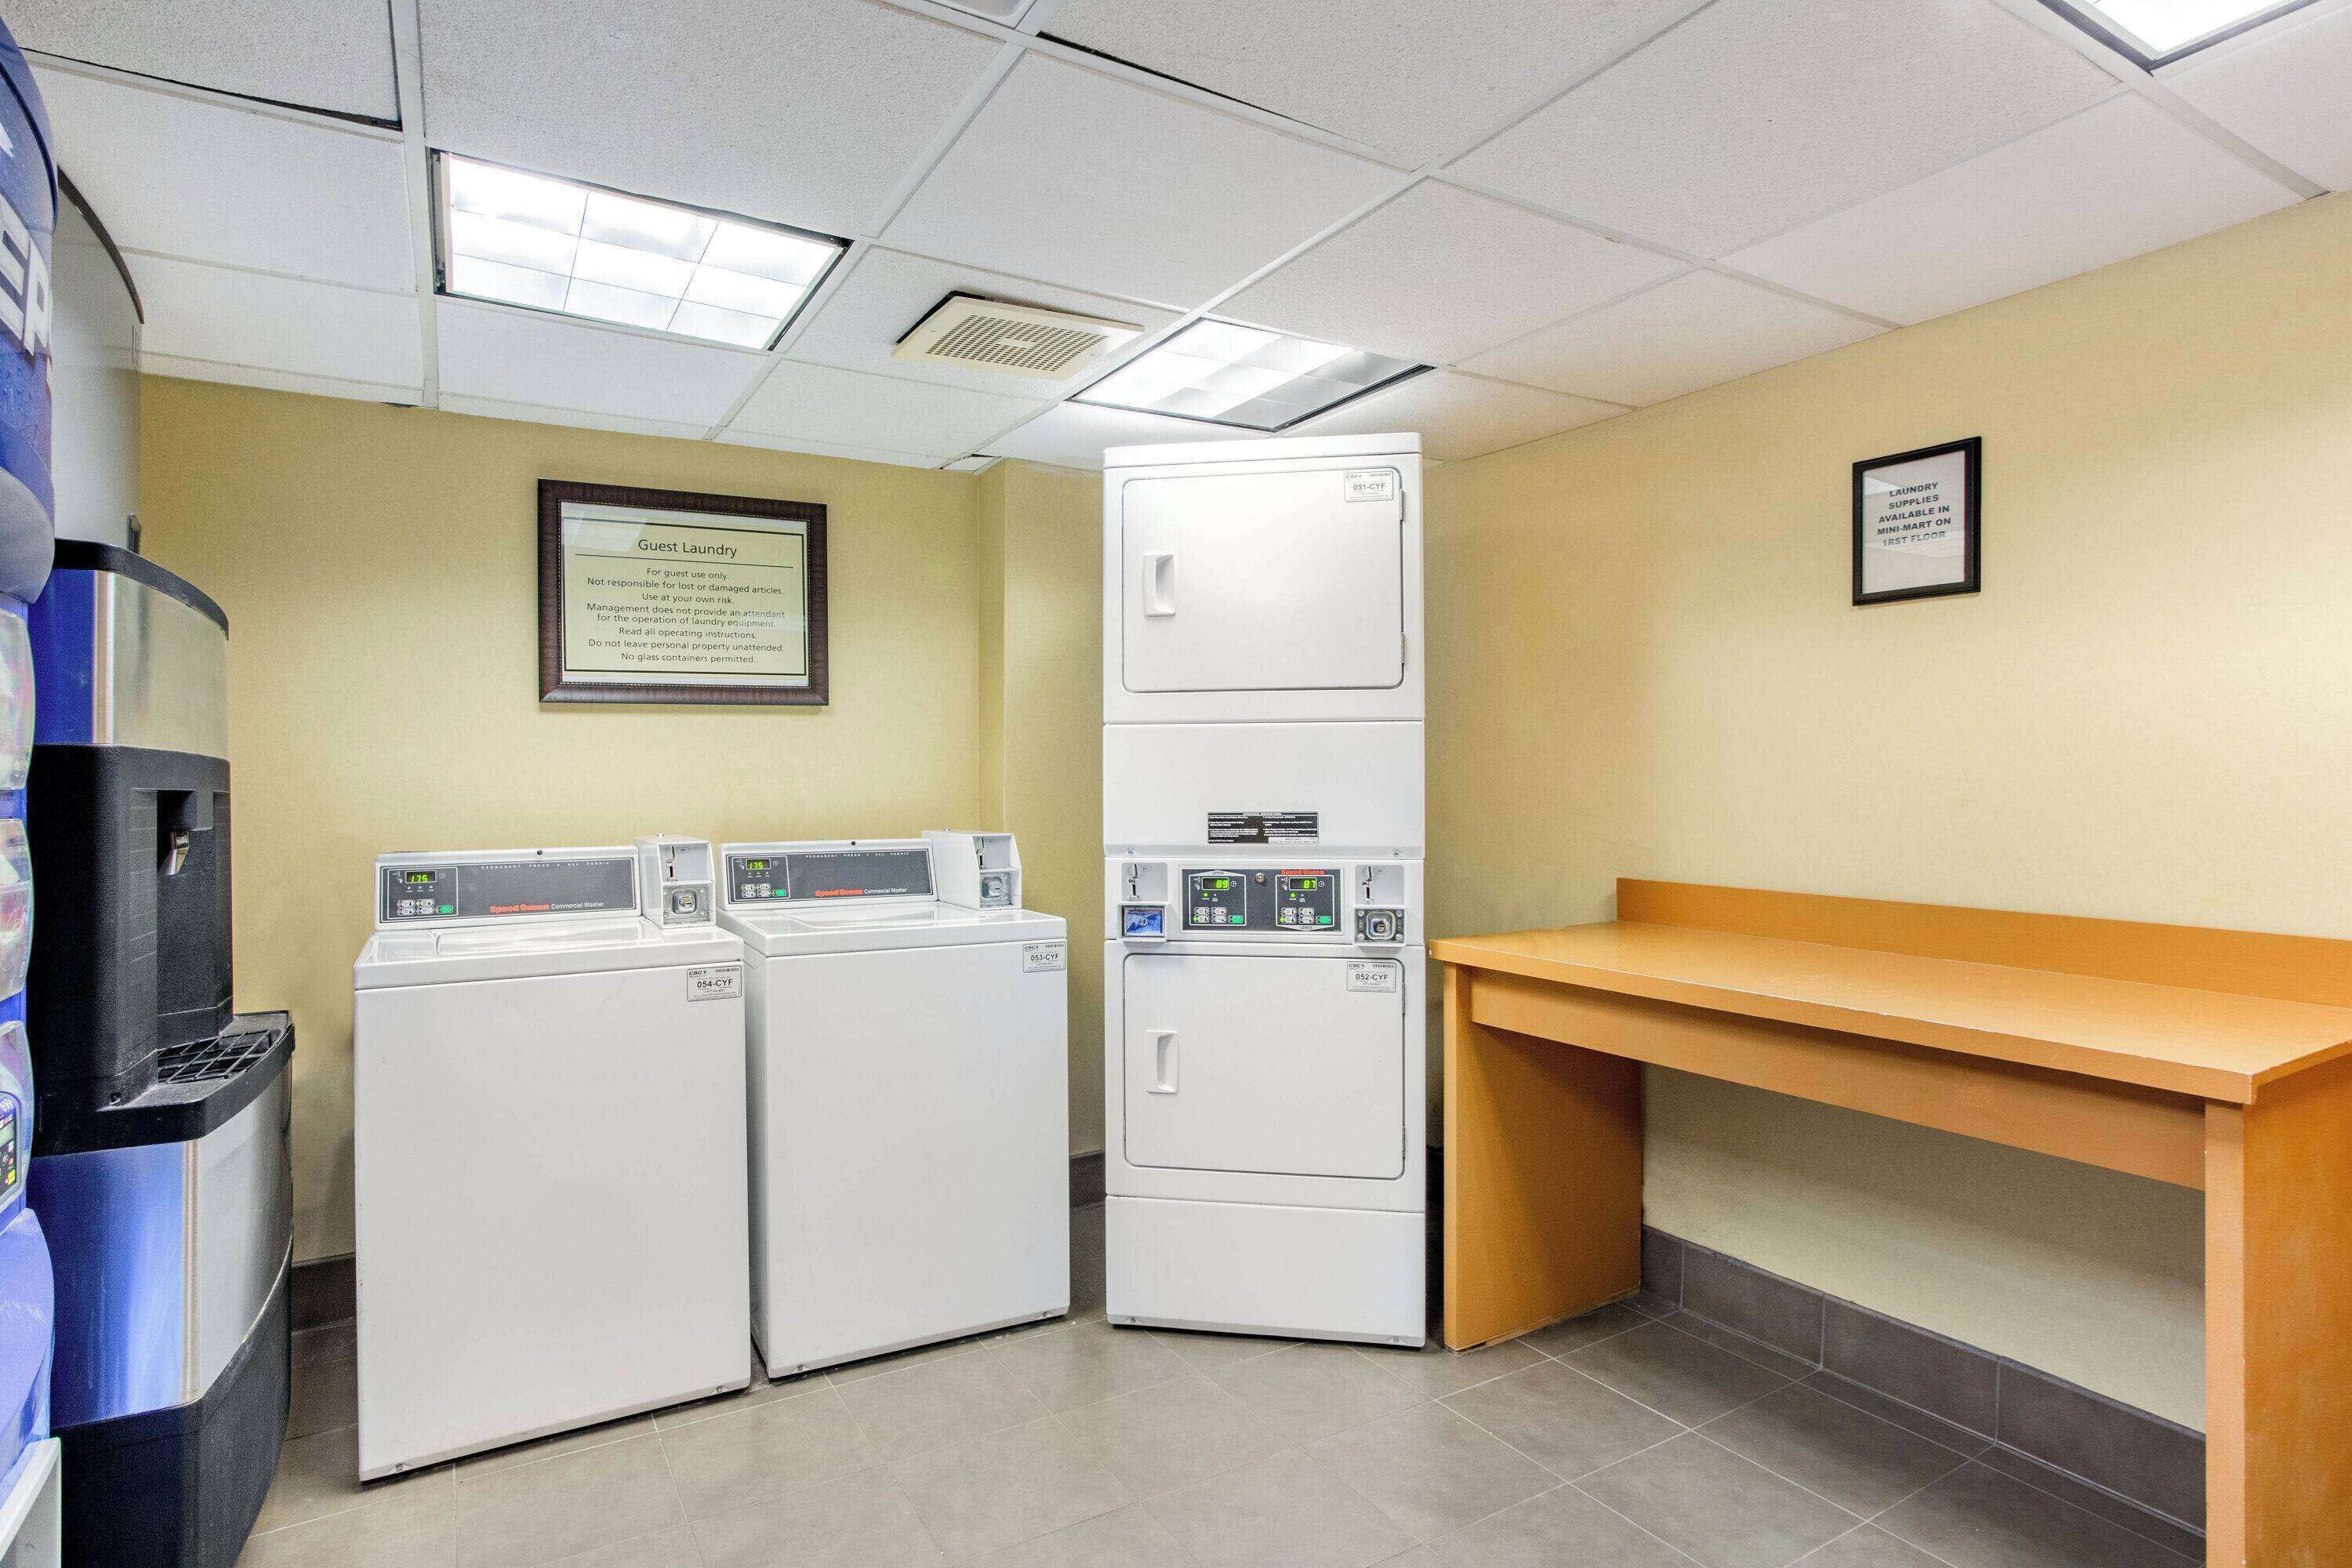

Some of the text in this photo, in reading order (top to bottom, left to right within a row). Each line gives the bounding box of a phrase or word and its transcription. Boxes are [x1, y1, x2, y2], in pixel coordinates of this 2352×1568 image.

[1352, 482, 1386, 491] 051-CYF
[1889, 481, 1939, 498] LAUNDRY
[1889, 494, 1939, 510] SUPPLIES
[1878, 505, 1950, 524] AVAILABLE IN
[1877, 517, 1951, 535] MINI-MART ON
[1882, 531, 1946, 546] 1RST FLOOR
[638, 539, 737, 559] Guest Laundry
[647, 568, 662, 576] For
[664, 570, 688, 579] guest
[708, 572, 730, 581] only.
[587, 577, 604, 586] Not
[608, 579, 659, 589] responsible
[662, 581, 676, 590] for
[678, 582, 695, 590] lost
[709, 583, 750, 593] damaged
[752, 586, 783, 594] articles.
[717, 596, 735, 604] risk.
[586, 603, 650, 613] Management
[652, 605, 673, 614] does
[742, 610, 785, 619] attendant
[597, 613, 611, 622] for
[614, 614, 630, 622] the
[691, 617, 725, 626] laundry
[728, 619, 777, 628] equipment.
[658, 630, 702, 639] operating
[705, 630, 757, 639] instructions.
[624, 639, 648, 648] leave
[692, 643, 730, 652] property
[732, 644, 785, 652] unattended.
[637, 653, 659, 662] glass
[710, 655, 756, 663] permitted.
[489, 903, 519, 914] Speed
[521, 902, 550, 912] Queen
[550, 902, 583, 910] Commercial
[697, 978, 734, 989] 054-CYF
